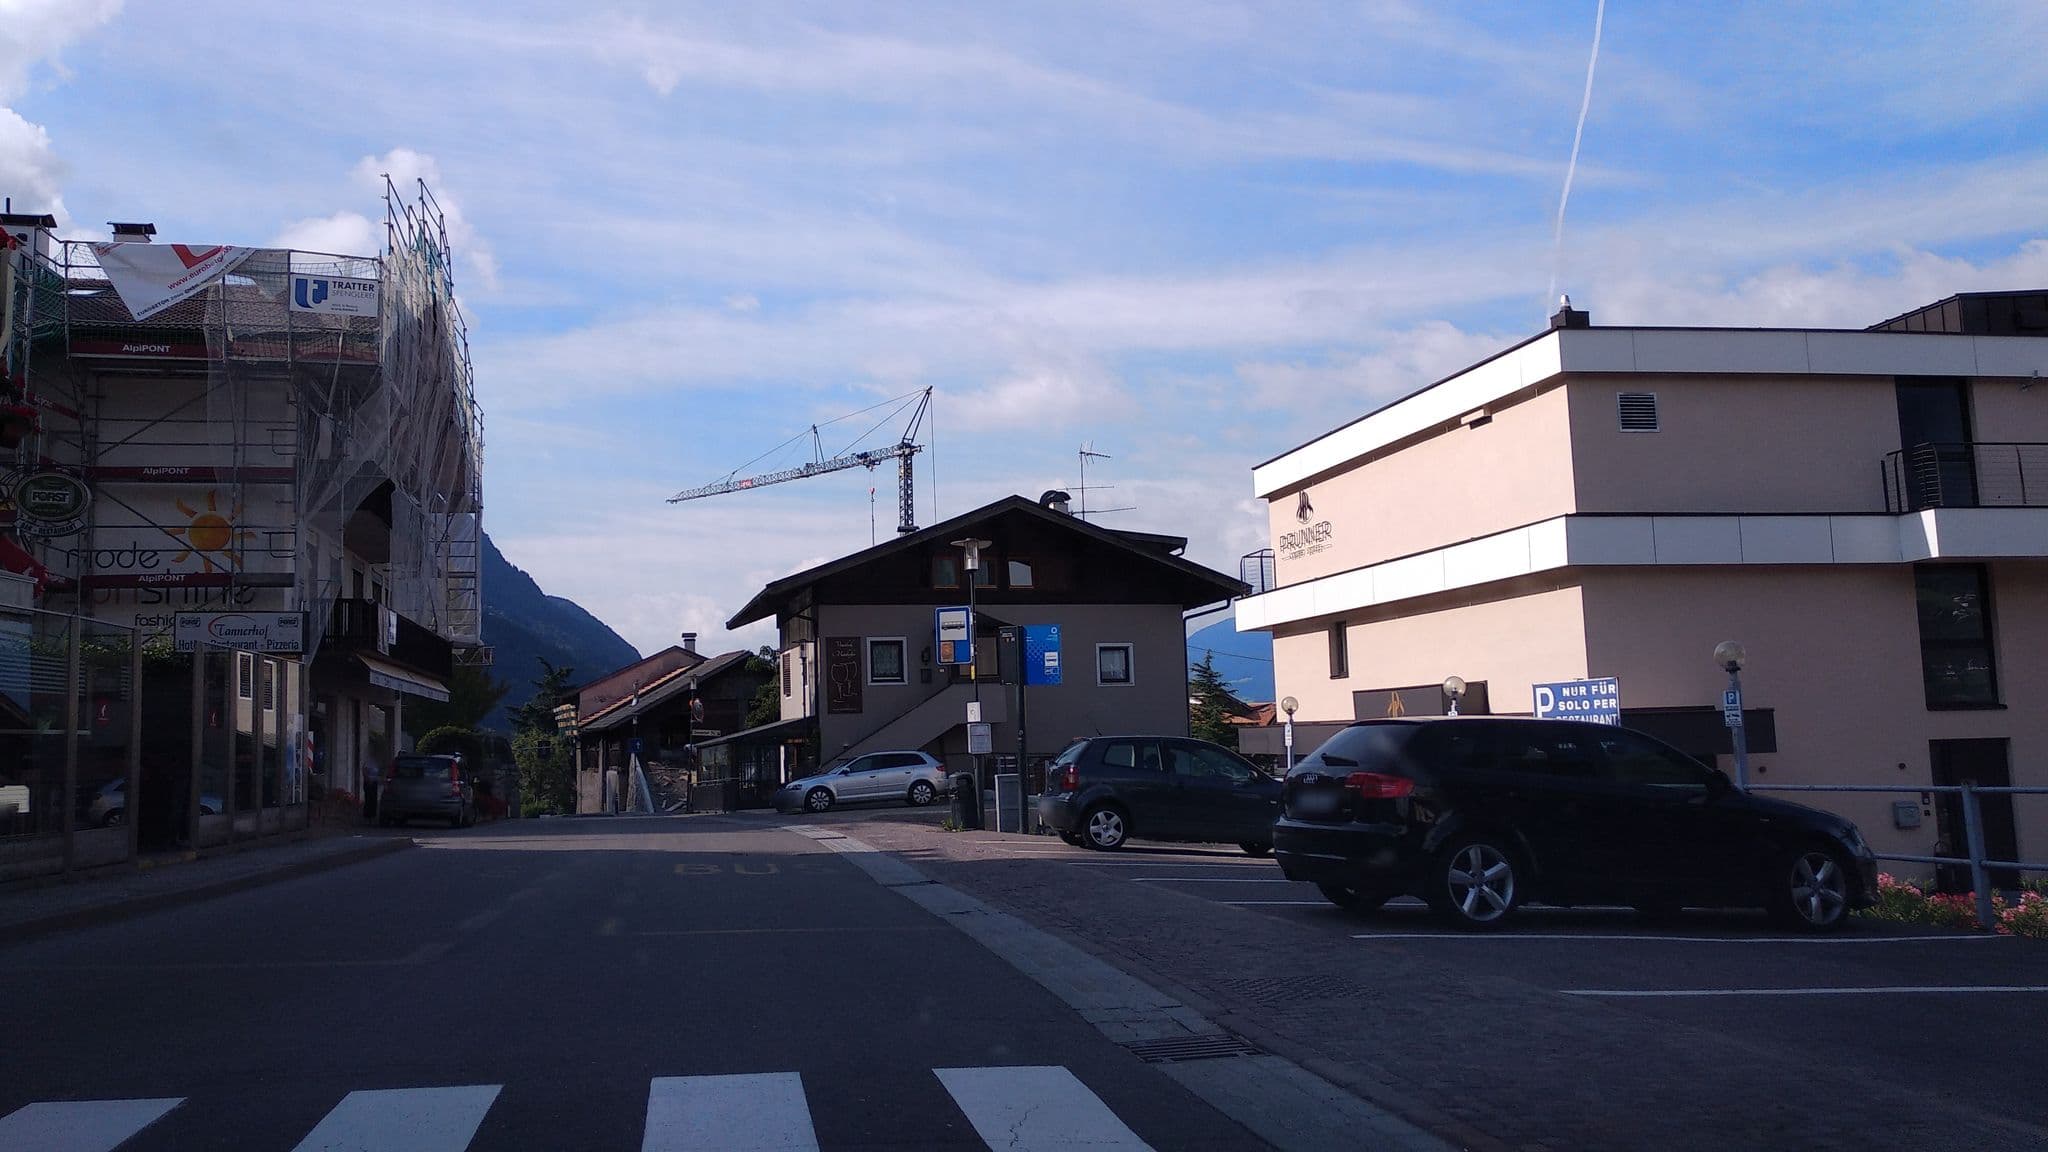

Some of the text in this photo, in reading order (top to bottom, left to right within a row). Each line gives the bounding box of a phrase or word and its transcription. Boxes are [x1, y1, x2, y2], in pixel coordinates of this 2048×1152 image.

[331, 280, 375, 292] TRATTER
[122, 344, 171, 353] AlpiPONT
[143, 467, 190, 476] AlpiPONT
[32, 491, 70, 503] FORST
[39, 523, 77, 536] RESTAURANT
[138, 574, 186, 583] AlpiPONT
[214, 623, 270, 639] Tannerhof
[267, 640, 299, 650] Pizzeria
[1562, 681, 1616, 697] NUR FÜR
[1535, 687, 1555, 718] P
[1558, 699, 1617, 711] SOLO PER
